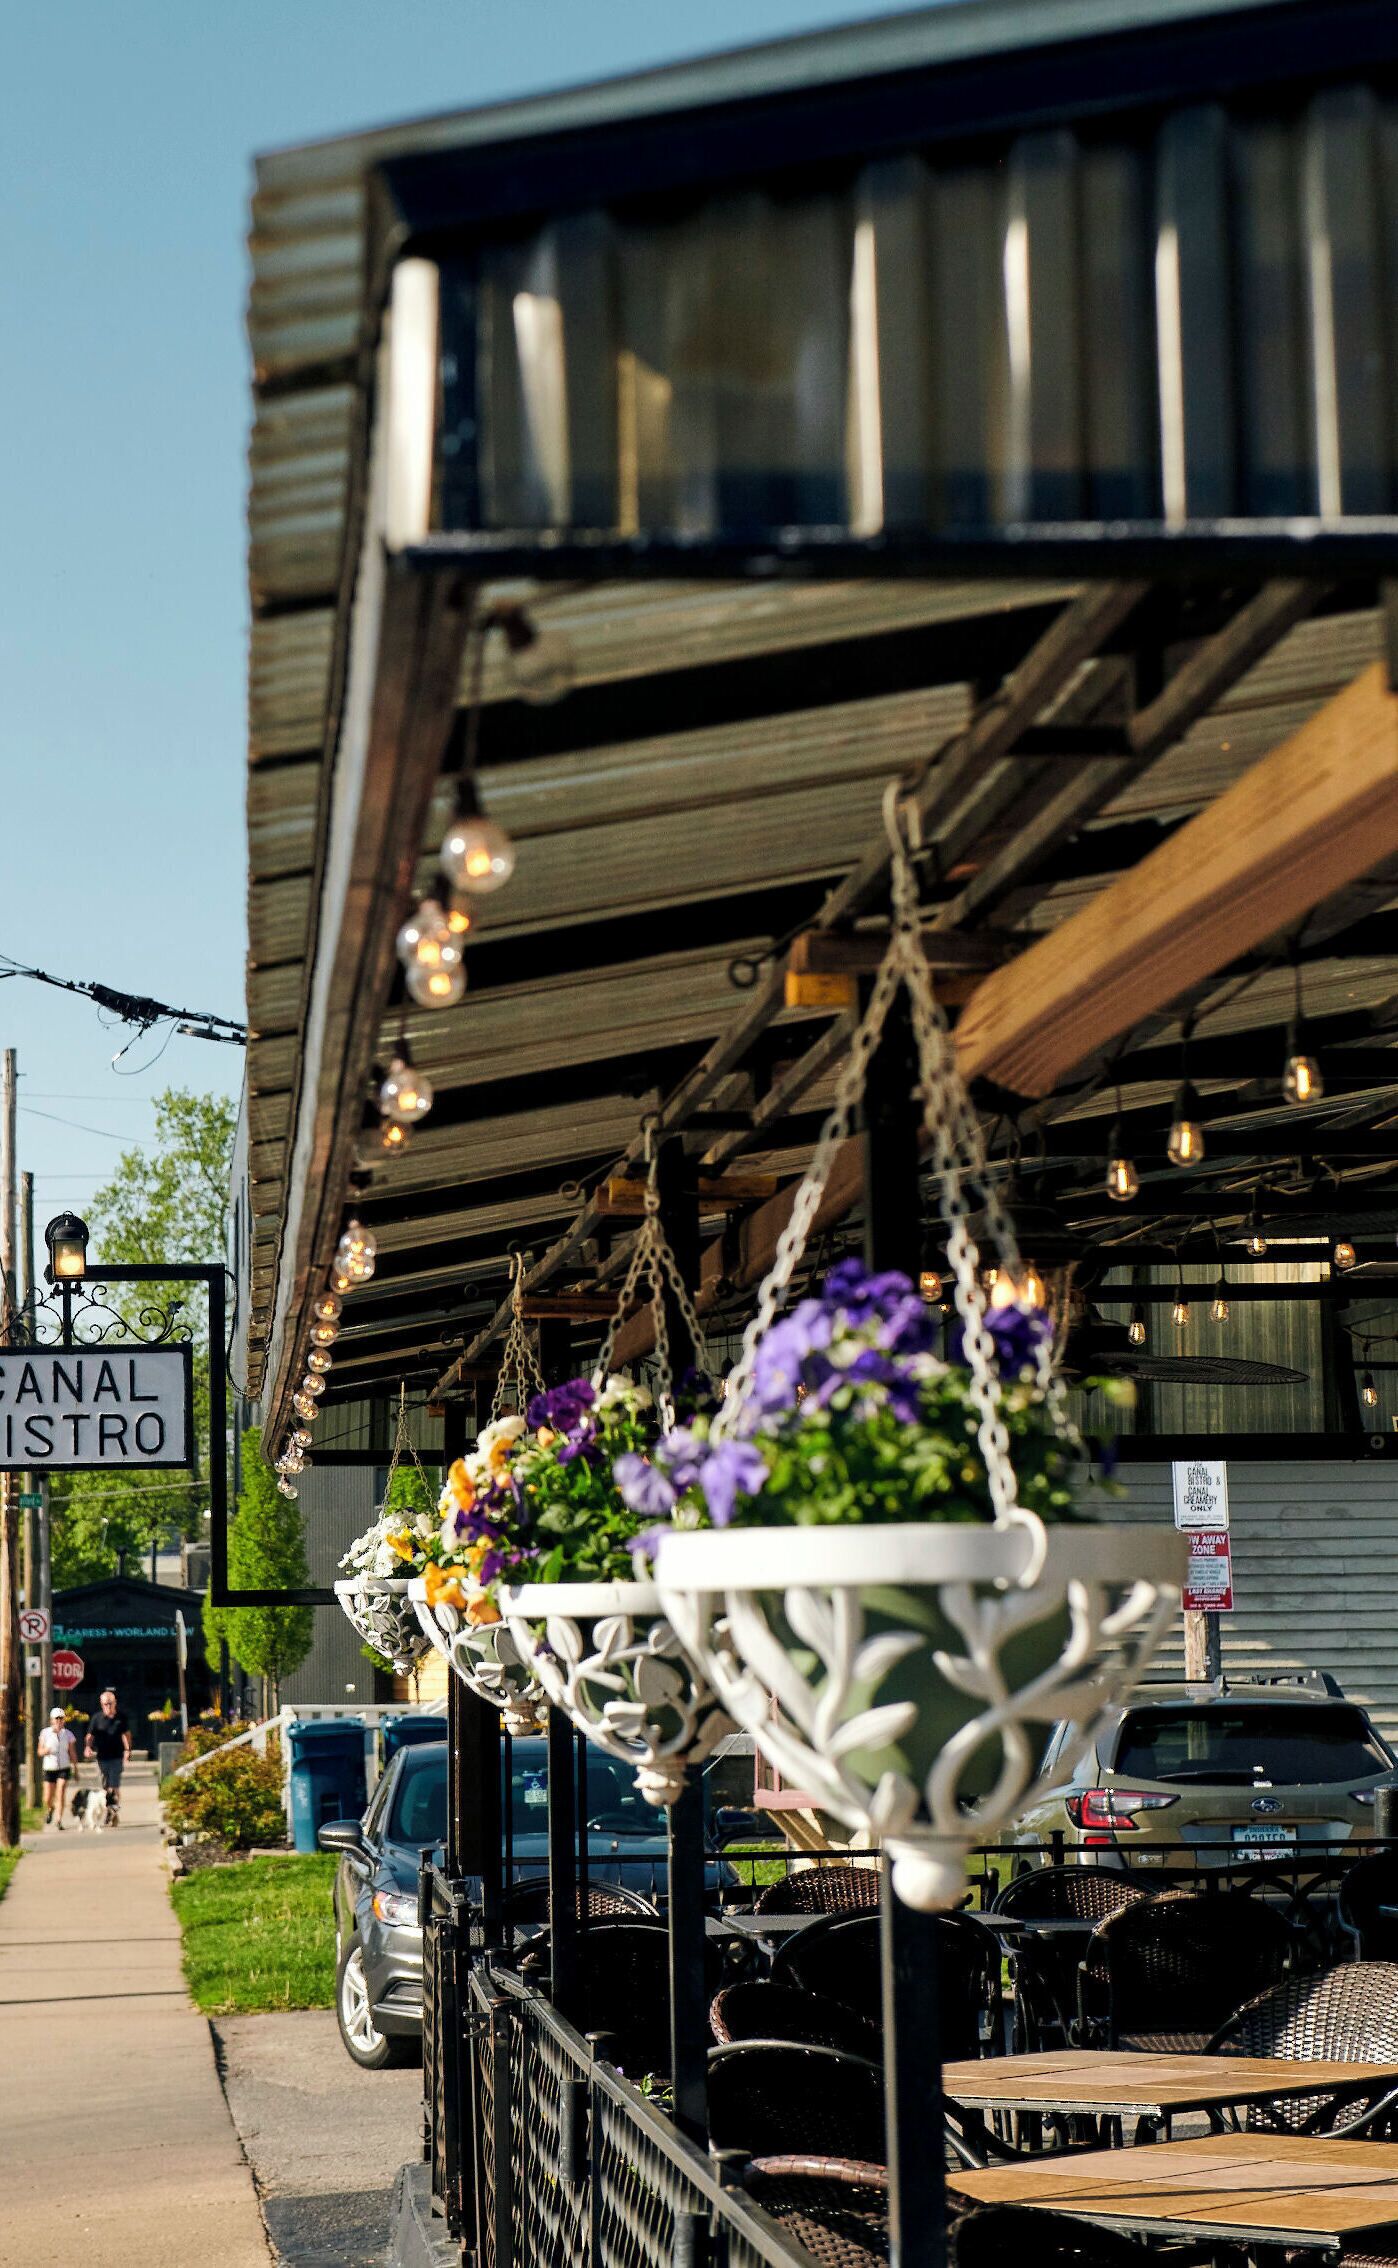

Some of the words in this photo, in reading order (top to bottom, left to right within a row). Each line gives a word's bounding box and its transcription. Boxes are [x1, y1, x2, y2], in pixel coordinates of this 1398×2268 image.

[0, 1360, 158, 1403] ANAL
[1187, 1486, 1208, 1496] CANAL
[1201, 1535, 1226, 1544] AWAY
[1192, 1544, 1216, 1555] ZONE
[113, 1627, 169, 1637] WORLAND
